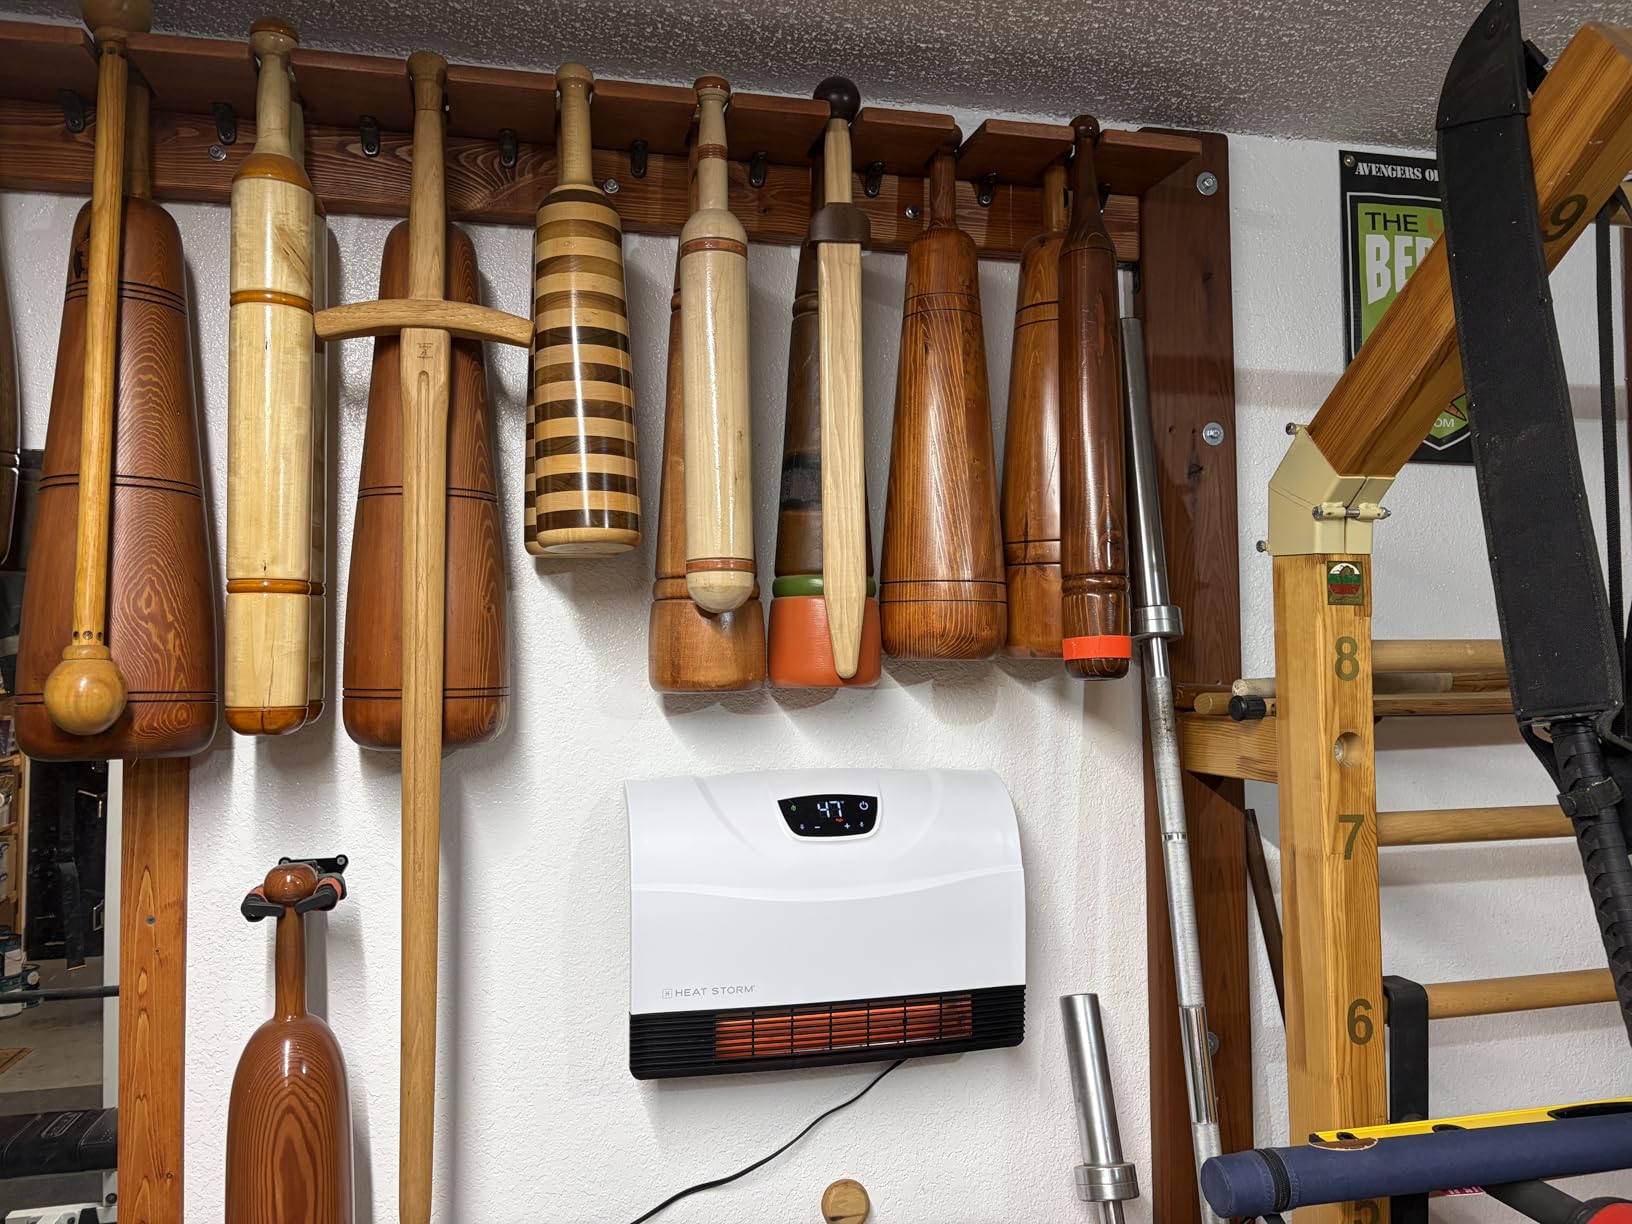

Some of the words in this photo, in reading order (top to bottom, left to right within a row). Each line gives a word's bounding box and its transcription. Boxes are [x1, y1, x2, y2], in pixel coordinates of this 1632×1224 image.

[1355, 162, 1422, 180] AVENGERS
[1365, 212, 1419, 233] THE
[1543, 194, 1588, 242] 9
[1335, 636, 1360, 681] 8
[817, 801, 842, 818] 47
[1338, 814, 1364, 860] 7
[675, 988, 707, 997] HEAT
[712, 985, 753, 995] STORM
[1347, 998, 1373, 1046] 6
